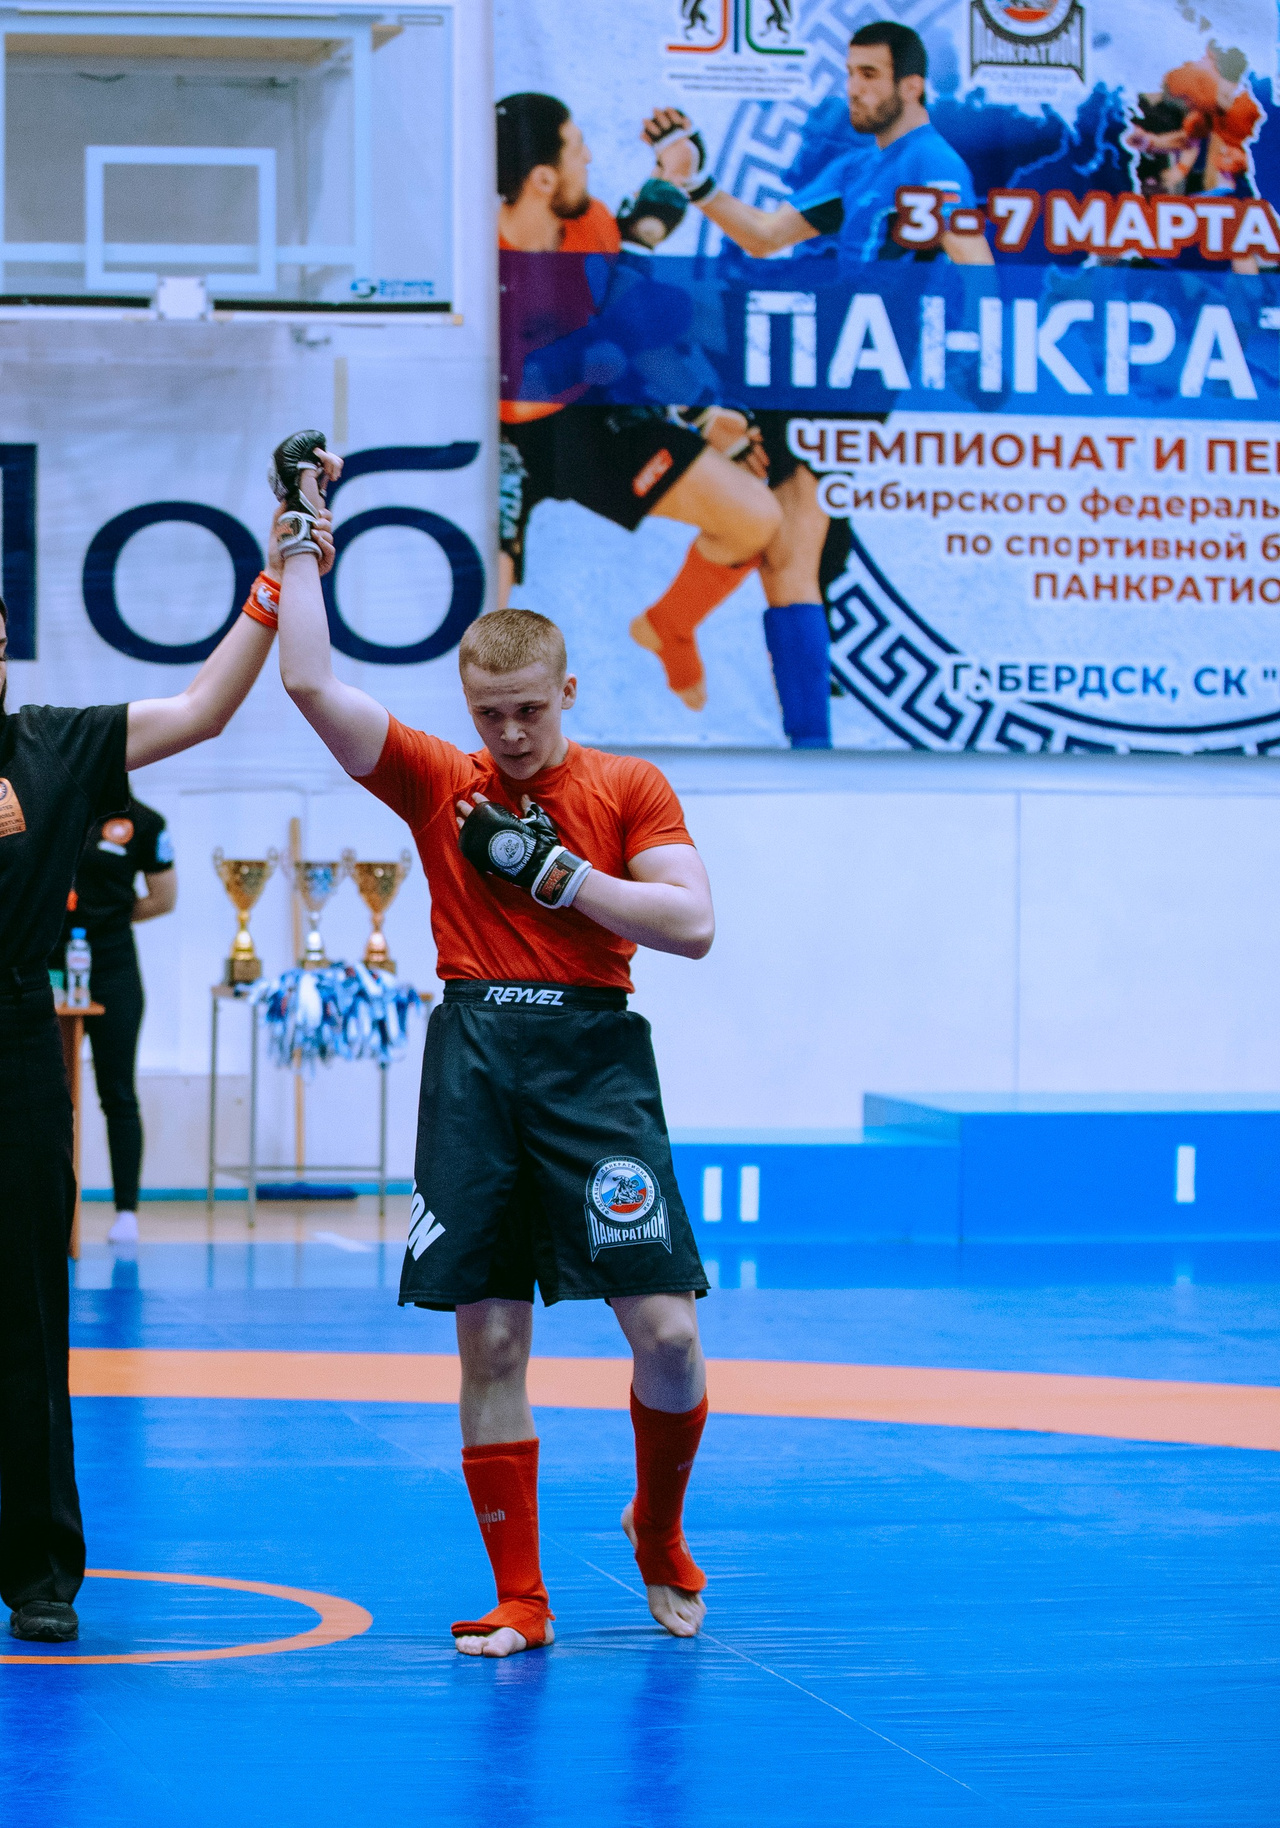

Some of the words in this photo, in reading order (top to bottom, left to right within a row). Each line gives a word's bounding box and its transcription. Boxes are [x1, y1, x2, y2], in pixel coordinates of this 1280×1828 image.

[900, 192, 939, 242] 3
[993, 196, 1034, 246] 7
[1052, 198, 1280, 254] МАРТА
[796, 428, 1136, 471] ЧЕМПИОНАТ
[1154, 437, 1186, 472] И
[1207, 438, 1280, 474] ПЕ
[825, 481, 1068, 518] Сибирского
[1080, 486, 1280, 526] федераль
[946, 534, 992, 556] по
[1005, 531, 1246, 565] спортивной
[1034, 572, 1280, 604] ПАНКРАТИО
[998, 664, 1179, 703] БЕРДСК,
[1194, 667, 1248, 697] СК
[483, 986, 565, 1006] REYVEL
[588, 1201, 667, 1248] ПАНКРАТИОН
